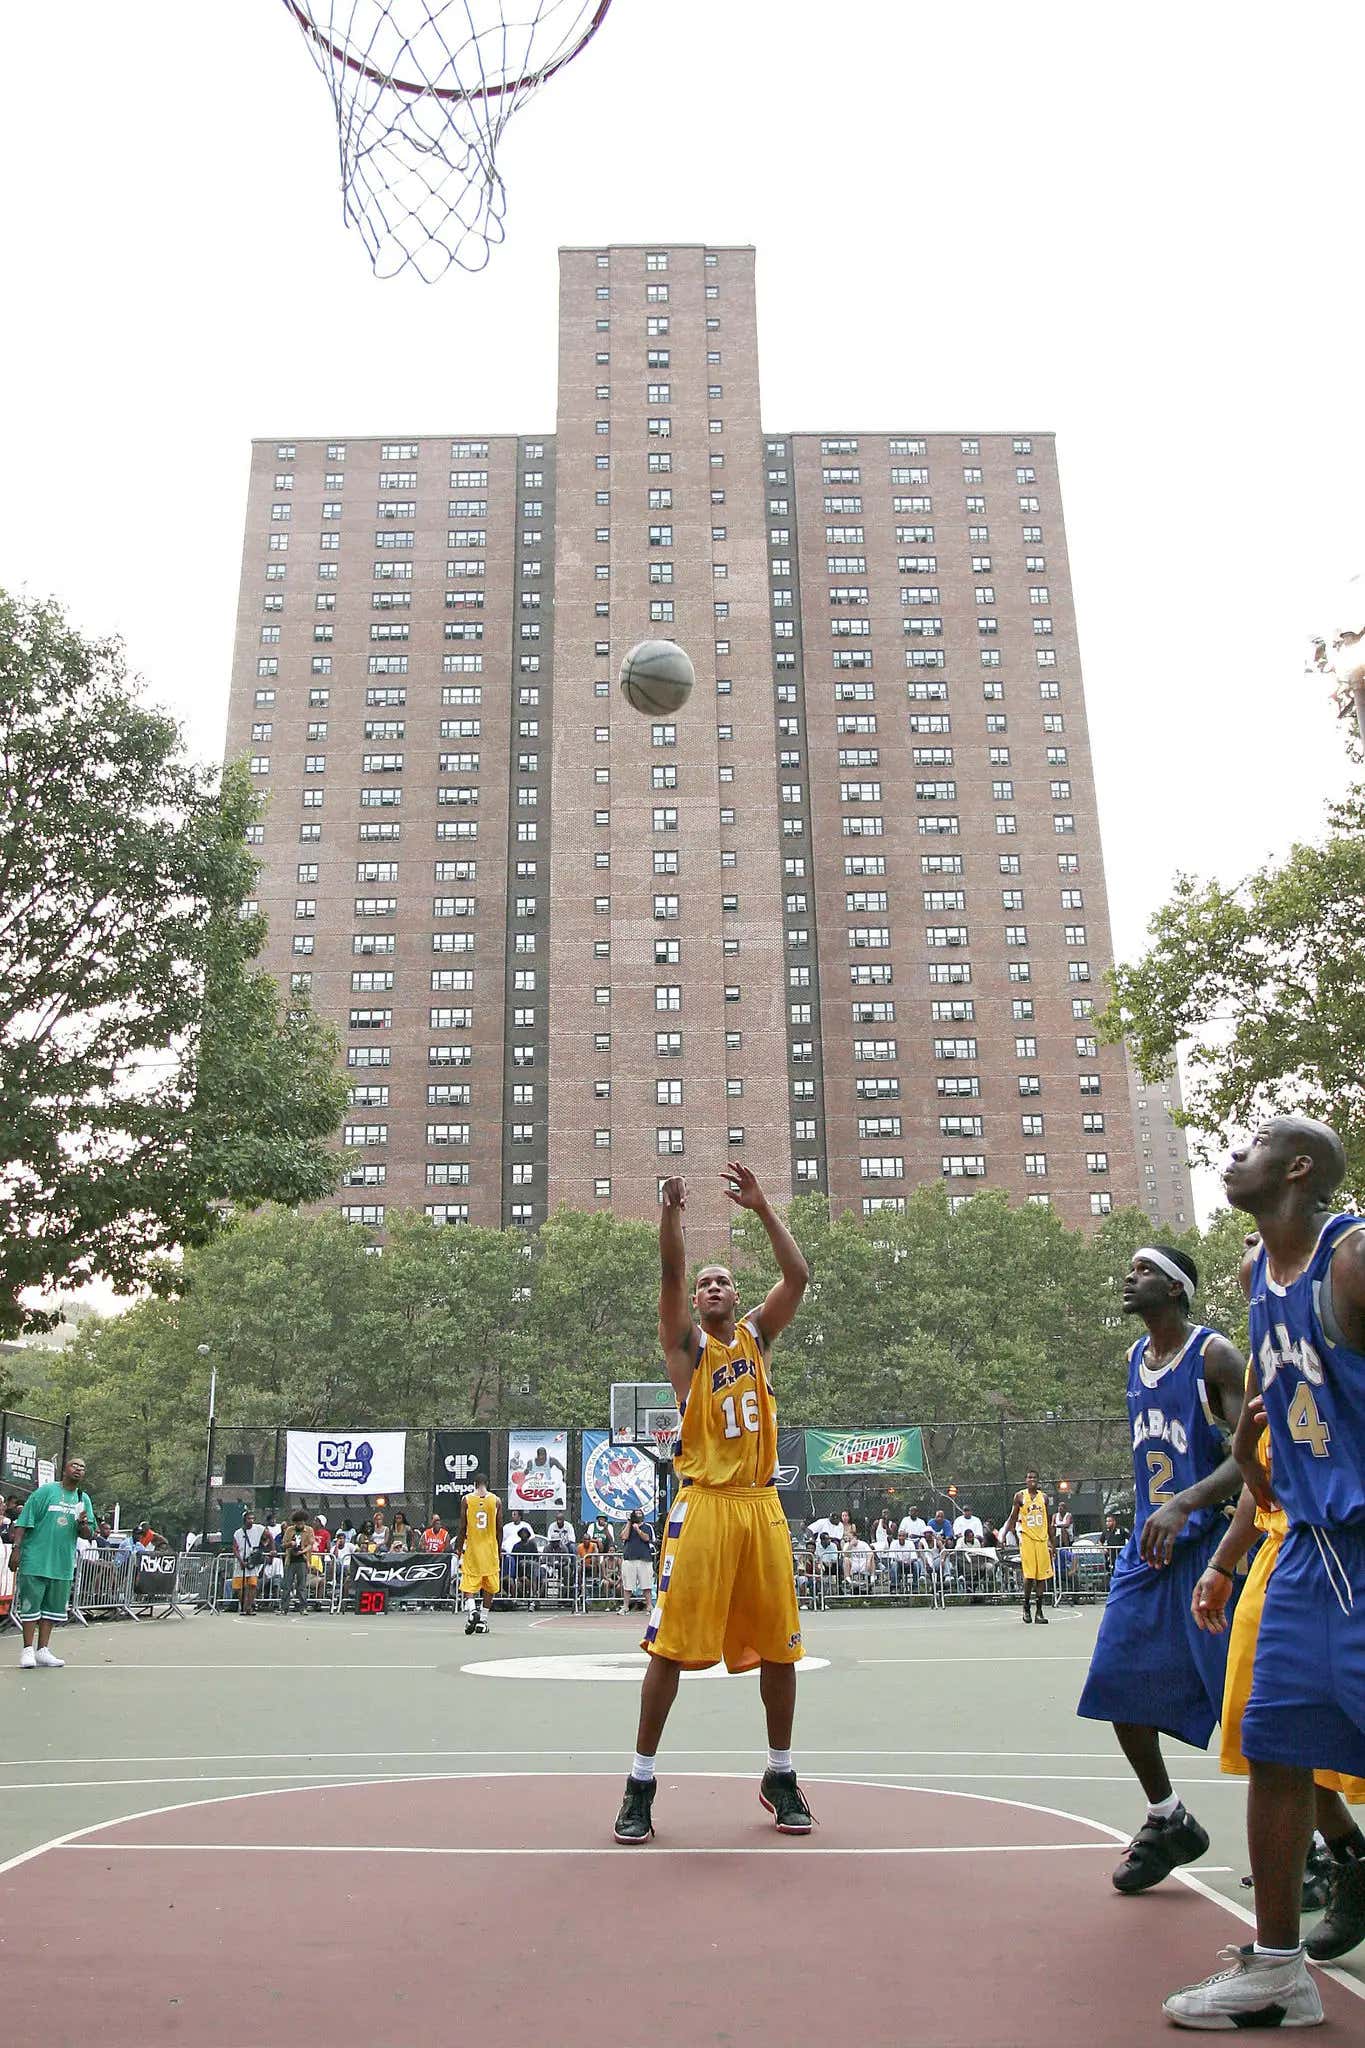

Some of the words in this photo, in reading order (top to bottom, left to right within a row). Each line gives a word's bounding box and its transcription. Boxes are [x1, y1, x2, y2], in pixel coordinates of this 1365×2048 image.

[721, 1390, 760, 1439] 16
[1287, 1381, 1331, 1457] 4
[320, 1442, 350, 1463] Def
[326, 1452, 363, 1471] Jam
[320, 1470, 363, 1480] recordings
[1146, 1451, 1175, 1505] 2
[524, 1488, 555, 1499] 2K6
[475, 1511, 488, 1529] 3
[1026, 1514, 1043, 1527] 20
[428, 1542, 439, 1552] 15
[360, 1591, 385, 1612] 30
